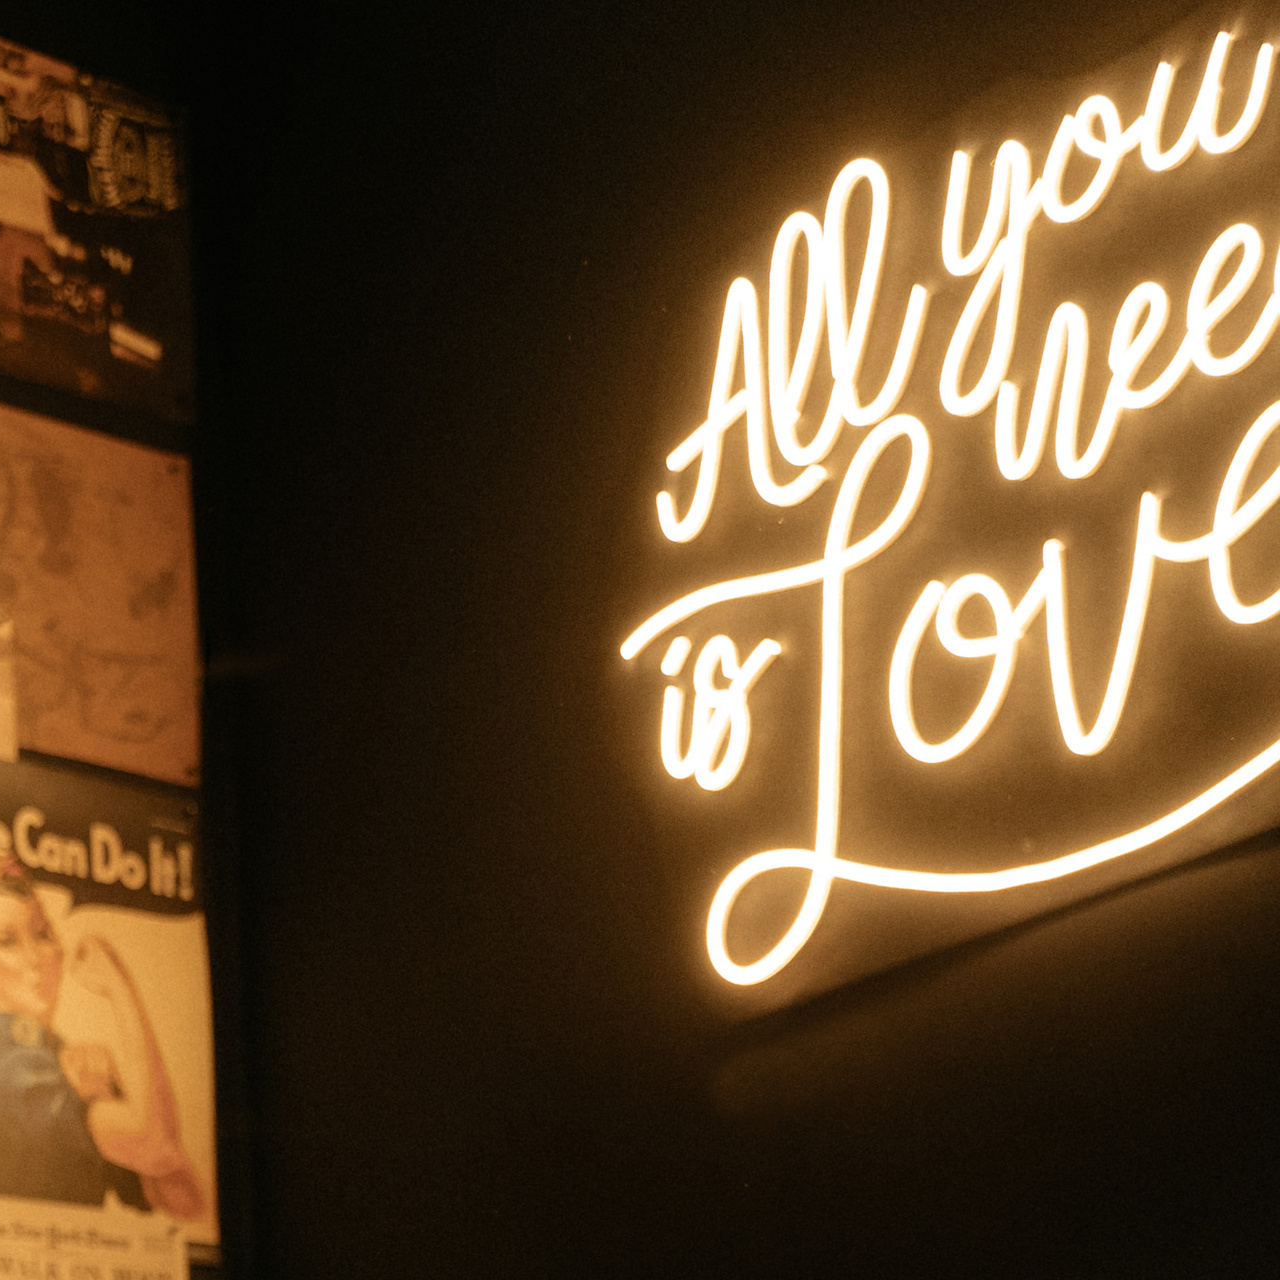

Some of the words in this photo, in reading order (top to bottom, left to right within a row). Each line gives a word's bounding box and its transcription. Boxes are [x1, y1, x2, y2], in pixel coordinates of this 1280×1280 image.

[655, 157, 928, 542] All
[940, 31, 1276, 417] you
[995, 222, 1280, 481] nee
[621, 398, 1280, 985] Love
[660, 635, 782, 791] is
[13, 804, 89, 880] Can
[89, 820, 147, 891] Do
[148, 834, 195, 902] It!
